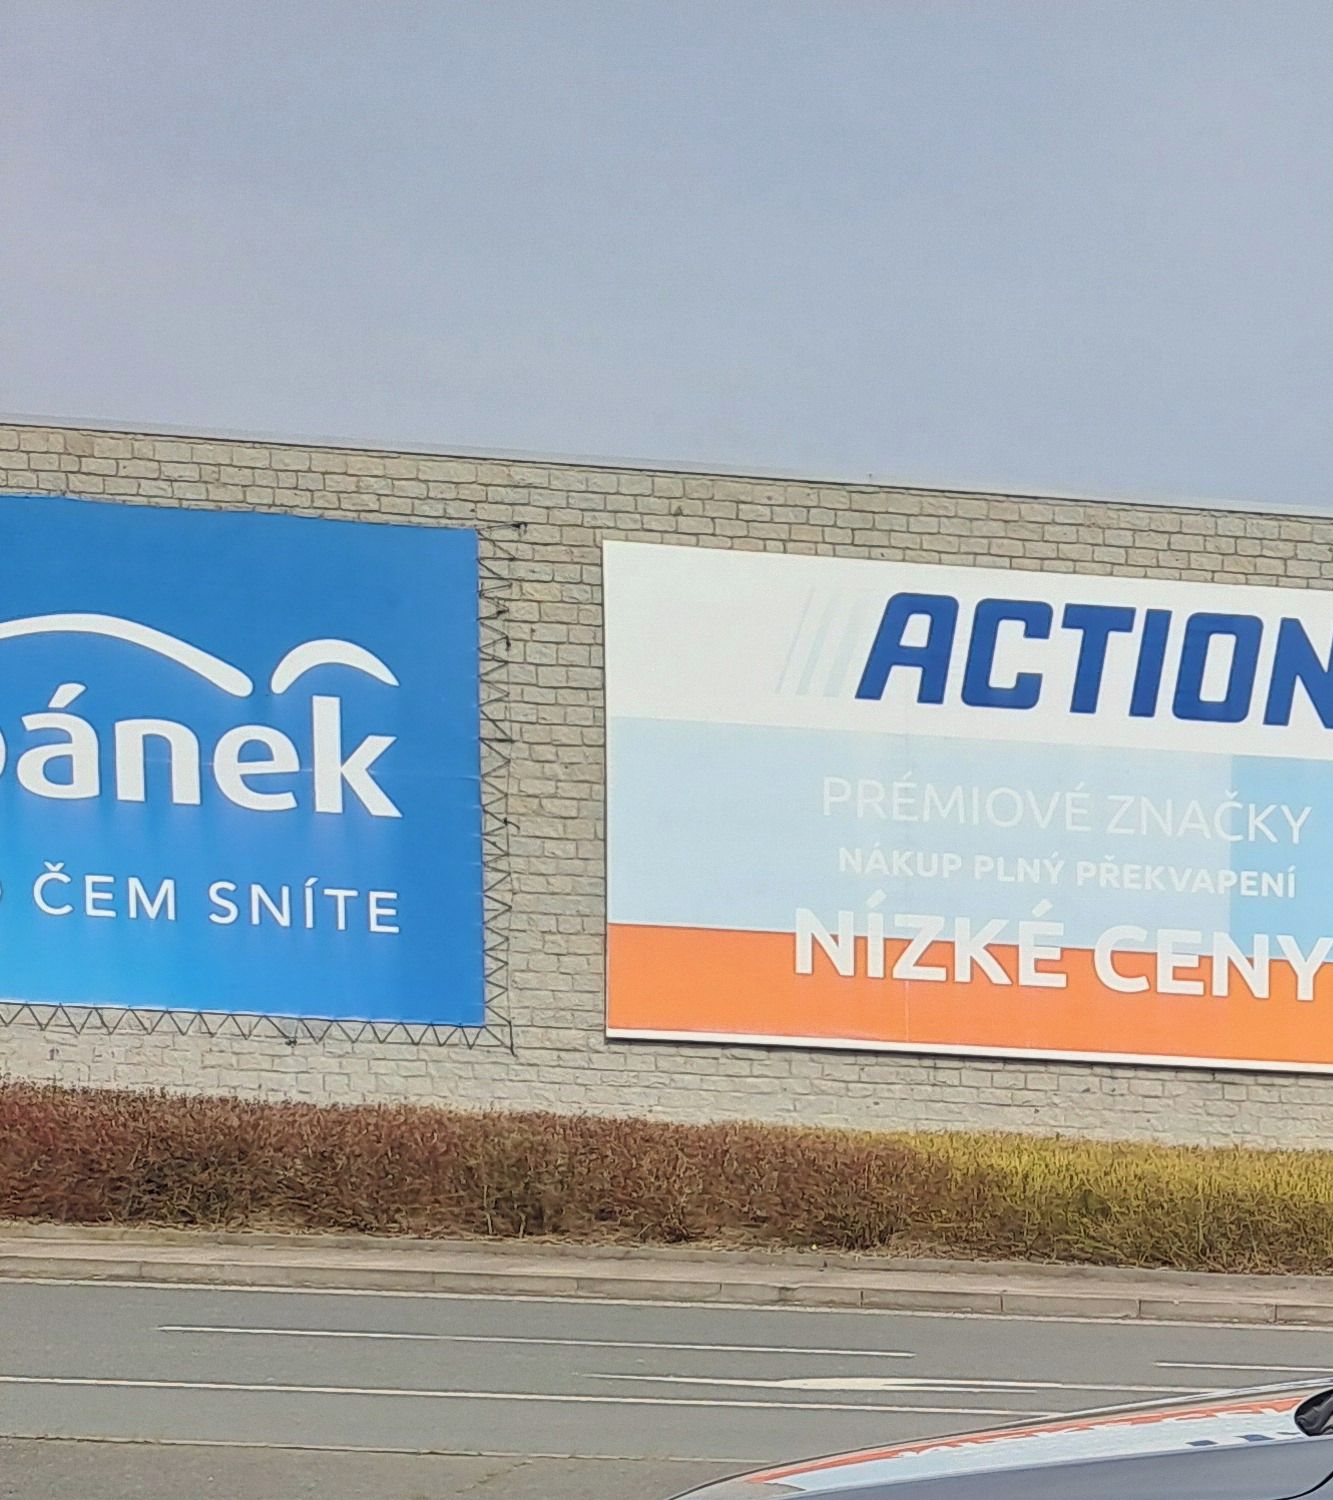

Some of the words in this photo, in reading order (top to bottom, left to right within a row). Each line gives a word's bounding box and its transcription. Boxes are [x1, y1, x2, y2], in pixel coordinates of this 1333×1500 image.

[0, 682, 403, 818] ánek
[821, 770, 1092, 832] PRÉMIOVÉ
[1106, 788, 1312, 844] ZNAČKY
[33, 861, 176, 922] ČEM
[208, 877, 401, 935] SNÍTE
[838, 841, 963, 878] NÁKUP
[974, 851, 1064, 885] PLNÝ
[1075, 853, 1297, 899] PŘEKVAPENÍ
[794, 888, 1069, 989] NÍZKÉ
